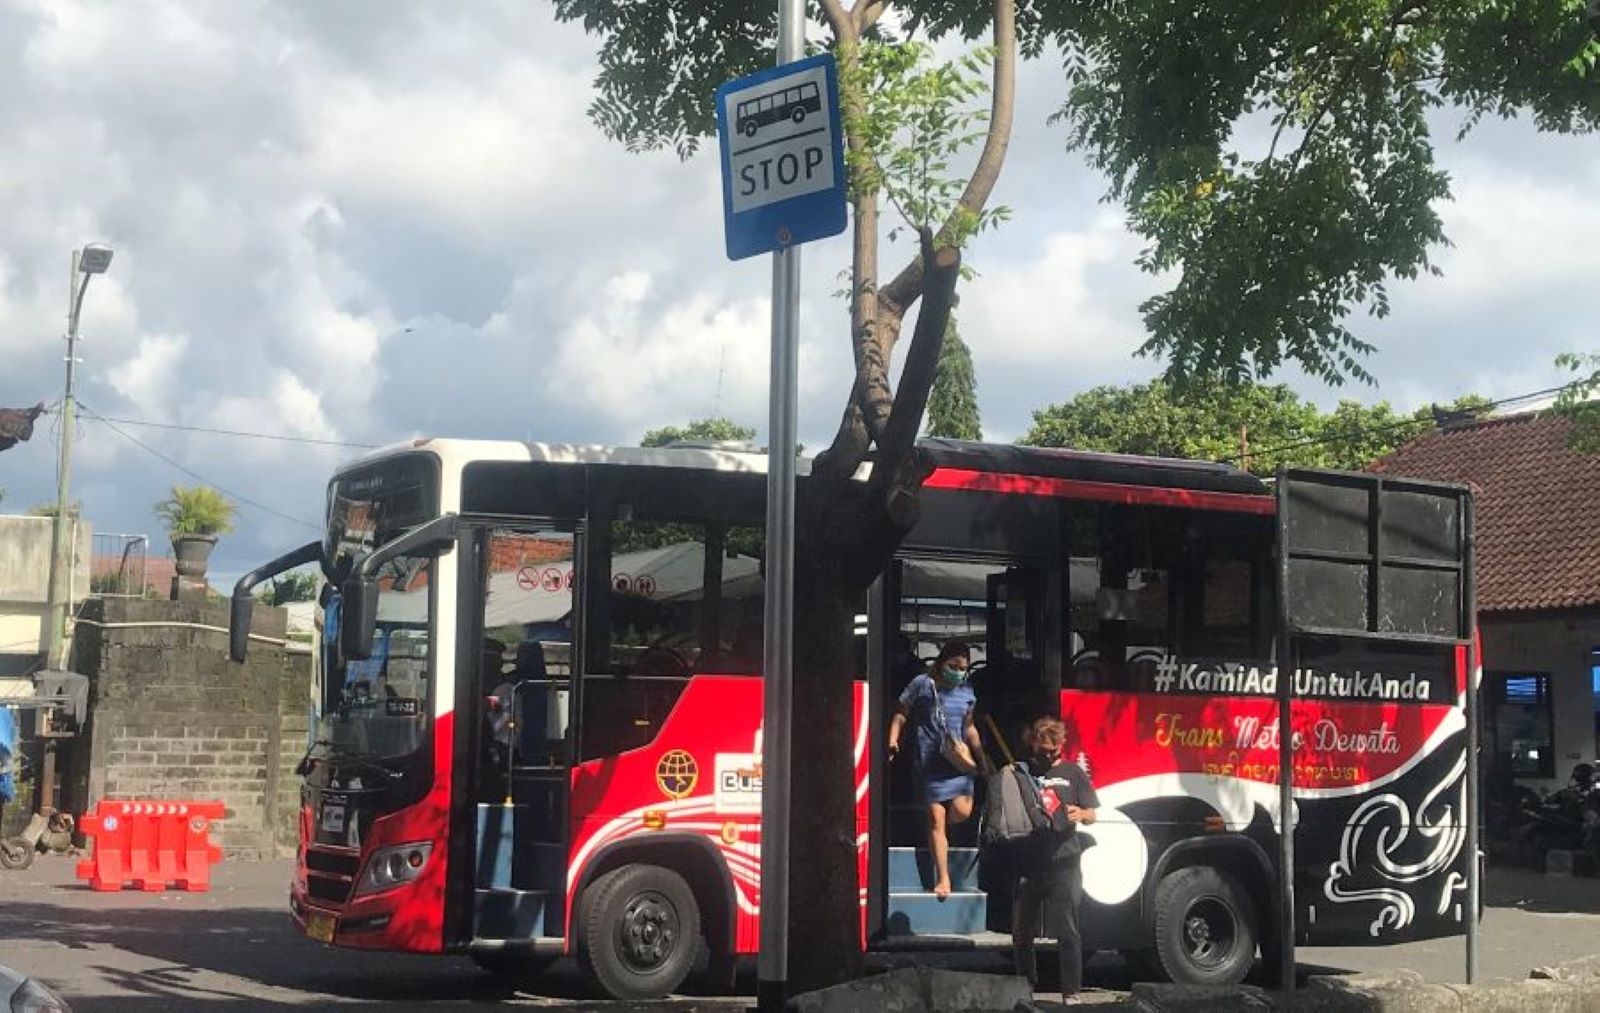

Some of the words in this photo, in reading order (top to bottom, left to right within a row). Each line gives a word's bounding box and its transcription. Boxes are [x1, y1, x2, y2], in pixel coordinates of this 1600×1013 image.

[740, 146, 824, 196] STOP
[1155, 655, 1430, 700] #KamiAdUntukAnda
[1155, 713, 1224, 748] Trans
[1235, 715, 1305, 751] Meto
[1314, 719, 1400, 754] Dewata
